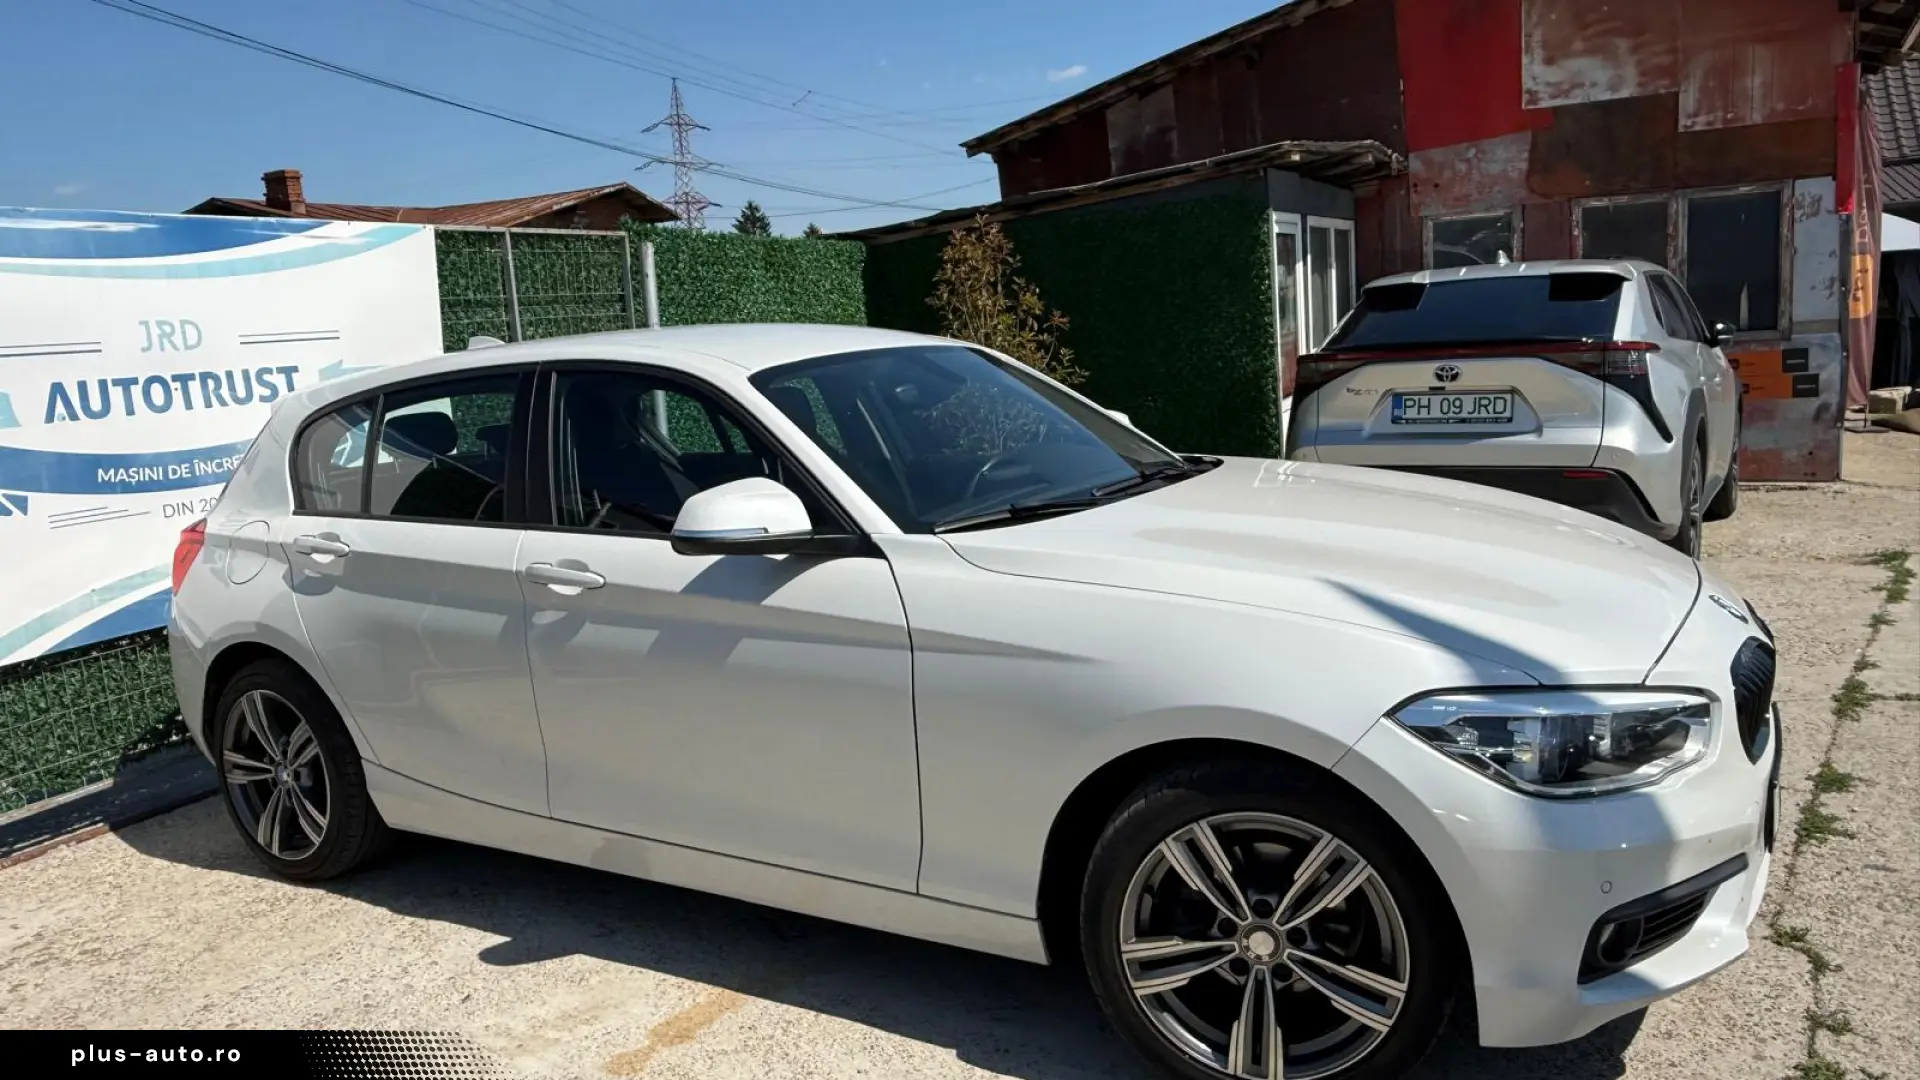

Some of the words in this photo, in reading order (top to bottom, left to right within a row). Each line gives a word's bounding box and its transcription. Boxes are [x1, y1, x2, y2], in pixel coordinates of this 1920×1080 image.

[138, 318, 204, 354] JRD
[44, 365, 300, 425] AUTOTRUST
[1403, 397, 1431, 416] PH
[1440, 397, 1463, 415] 09
[1467, 396, 1507, 415] JRD
[97, 466, 163, 485] MAȘINI
[168, 463, 191, 480] DE
[163, 500, 194, 518] DIN
